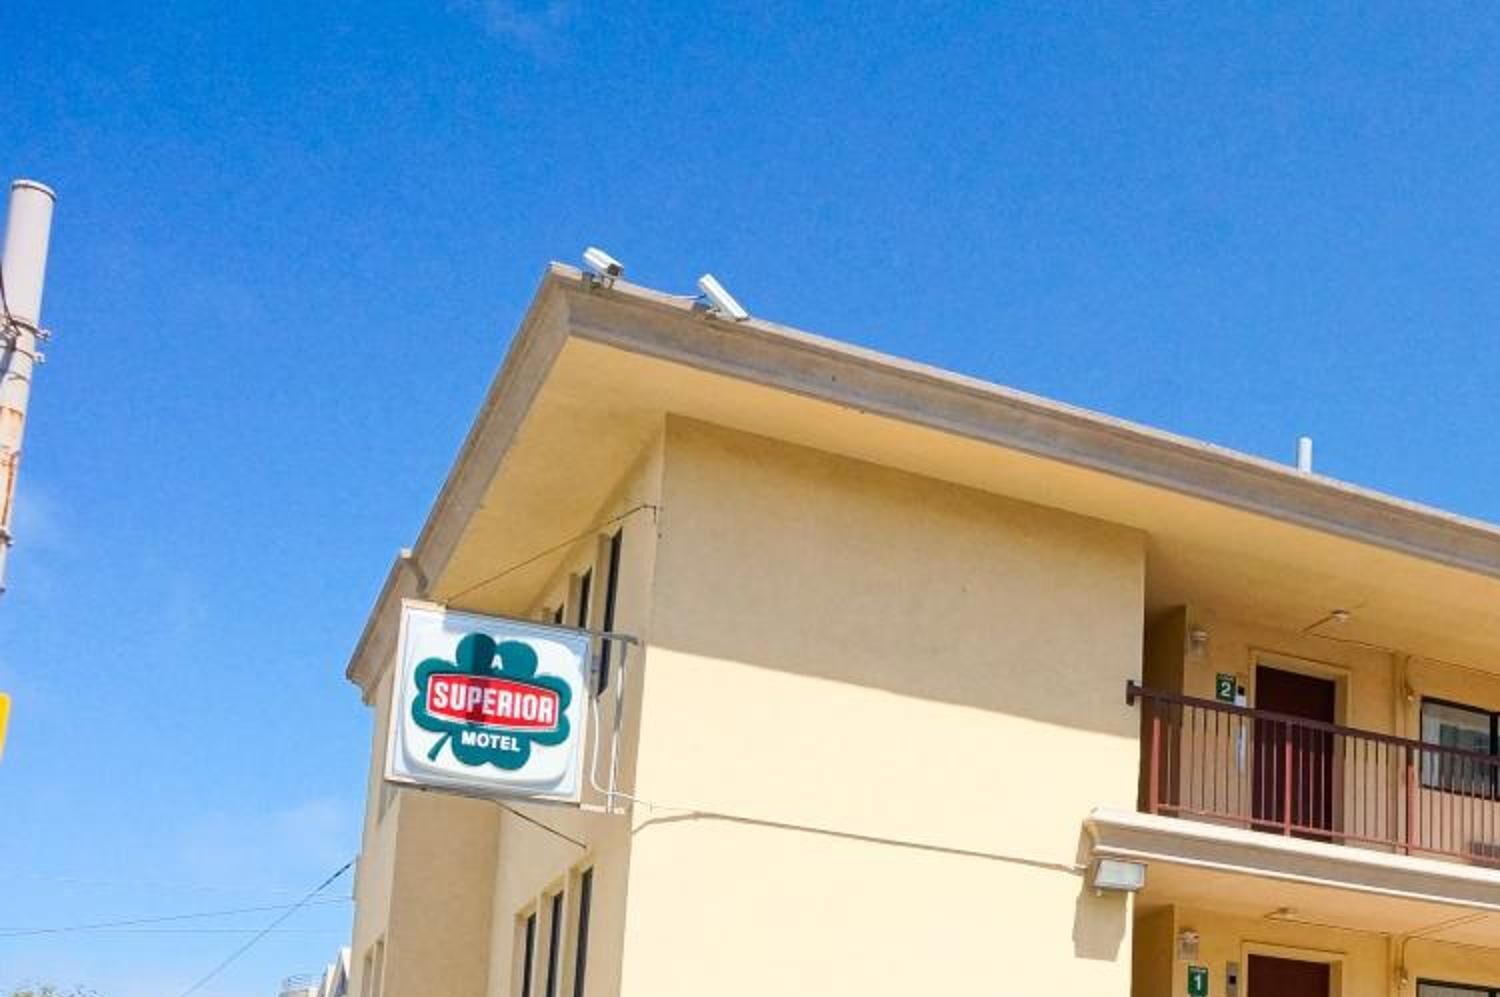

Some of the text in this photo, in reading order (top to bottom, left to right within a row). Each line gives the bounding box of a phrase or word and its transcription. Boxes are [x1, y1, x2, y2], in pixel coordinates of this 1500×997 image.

[491, 654, 503, 670] A
[1220, 681, 1231, 697] 2
[433, 682, 554, 723] SUPERIOR
[461, 730, 520, 752] MOTEL
[1193, 974, 1201, 991] 1
